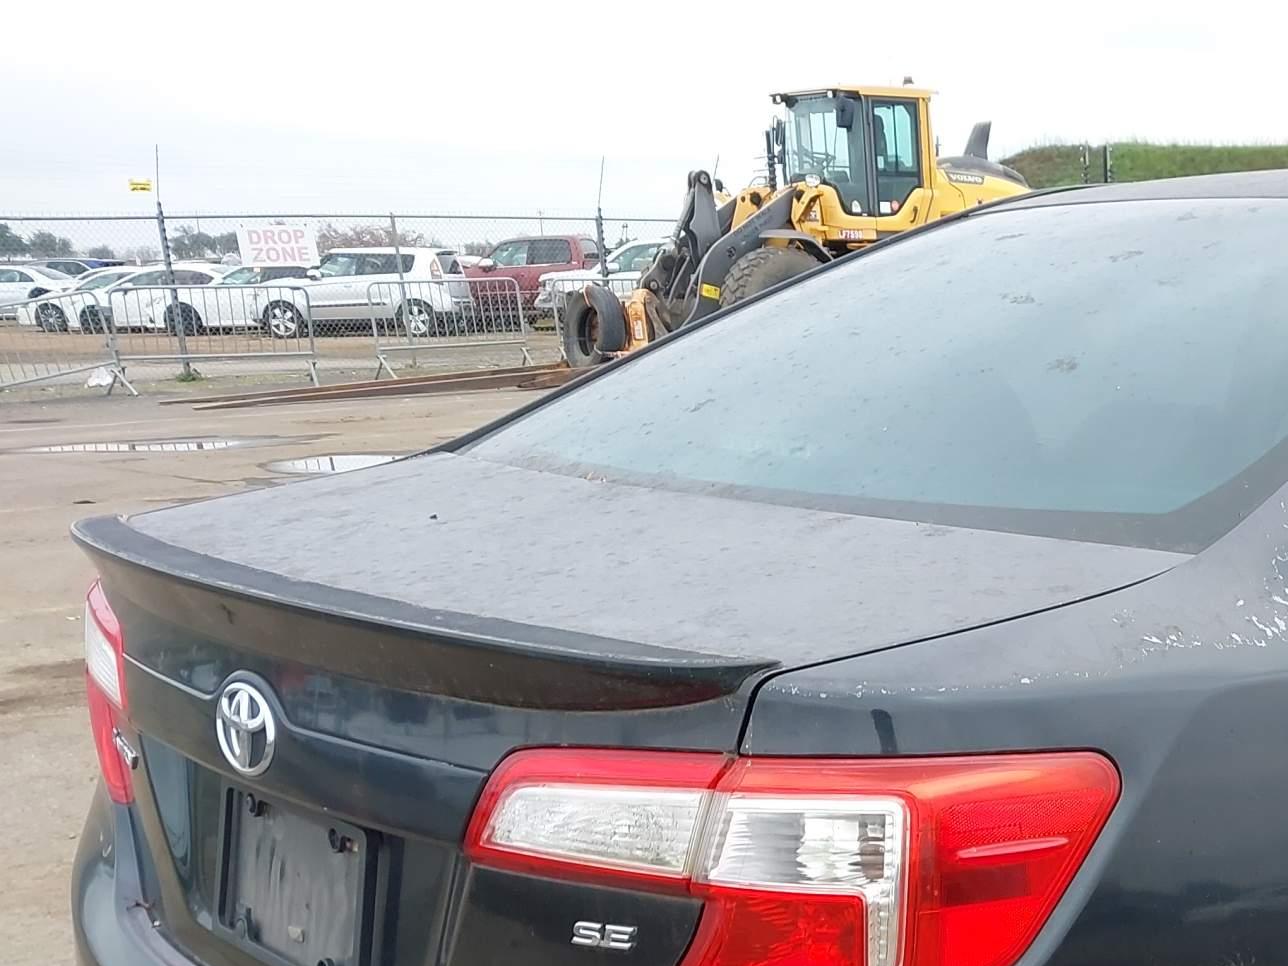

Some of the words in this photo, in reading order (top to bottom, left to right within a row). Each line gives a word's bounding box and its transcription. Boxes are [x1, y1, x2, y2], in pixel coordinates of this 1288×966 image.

[948, 173, 983, 183] VOLVO
[247, 229, 305, 245] DROP
[251, 246, 311, 263] ZONE
[570, 920, 638, 951] SE
